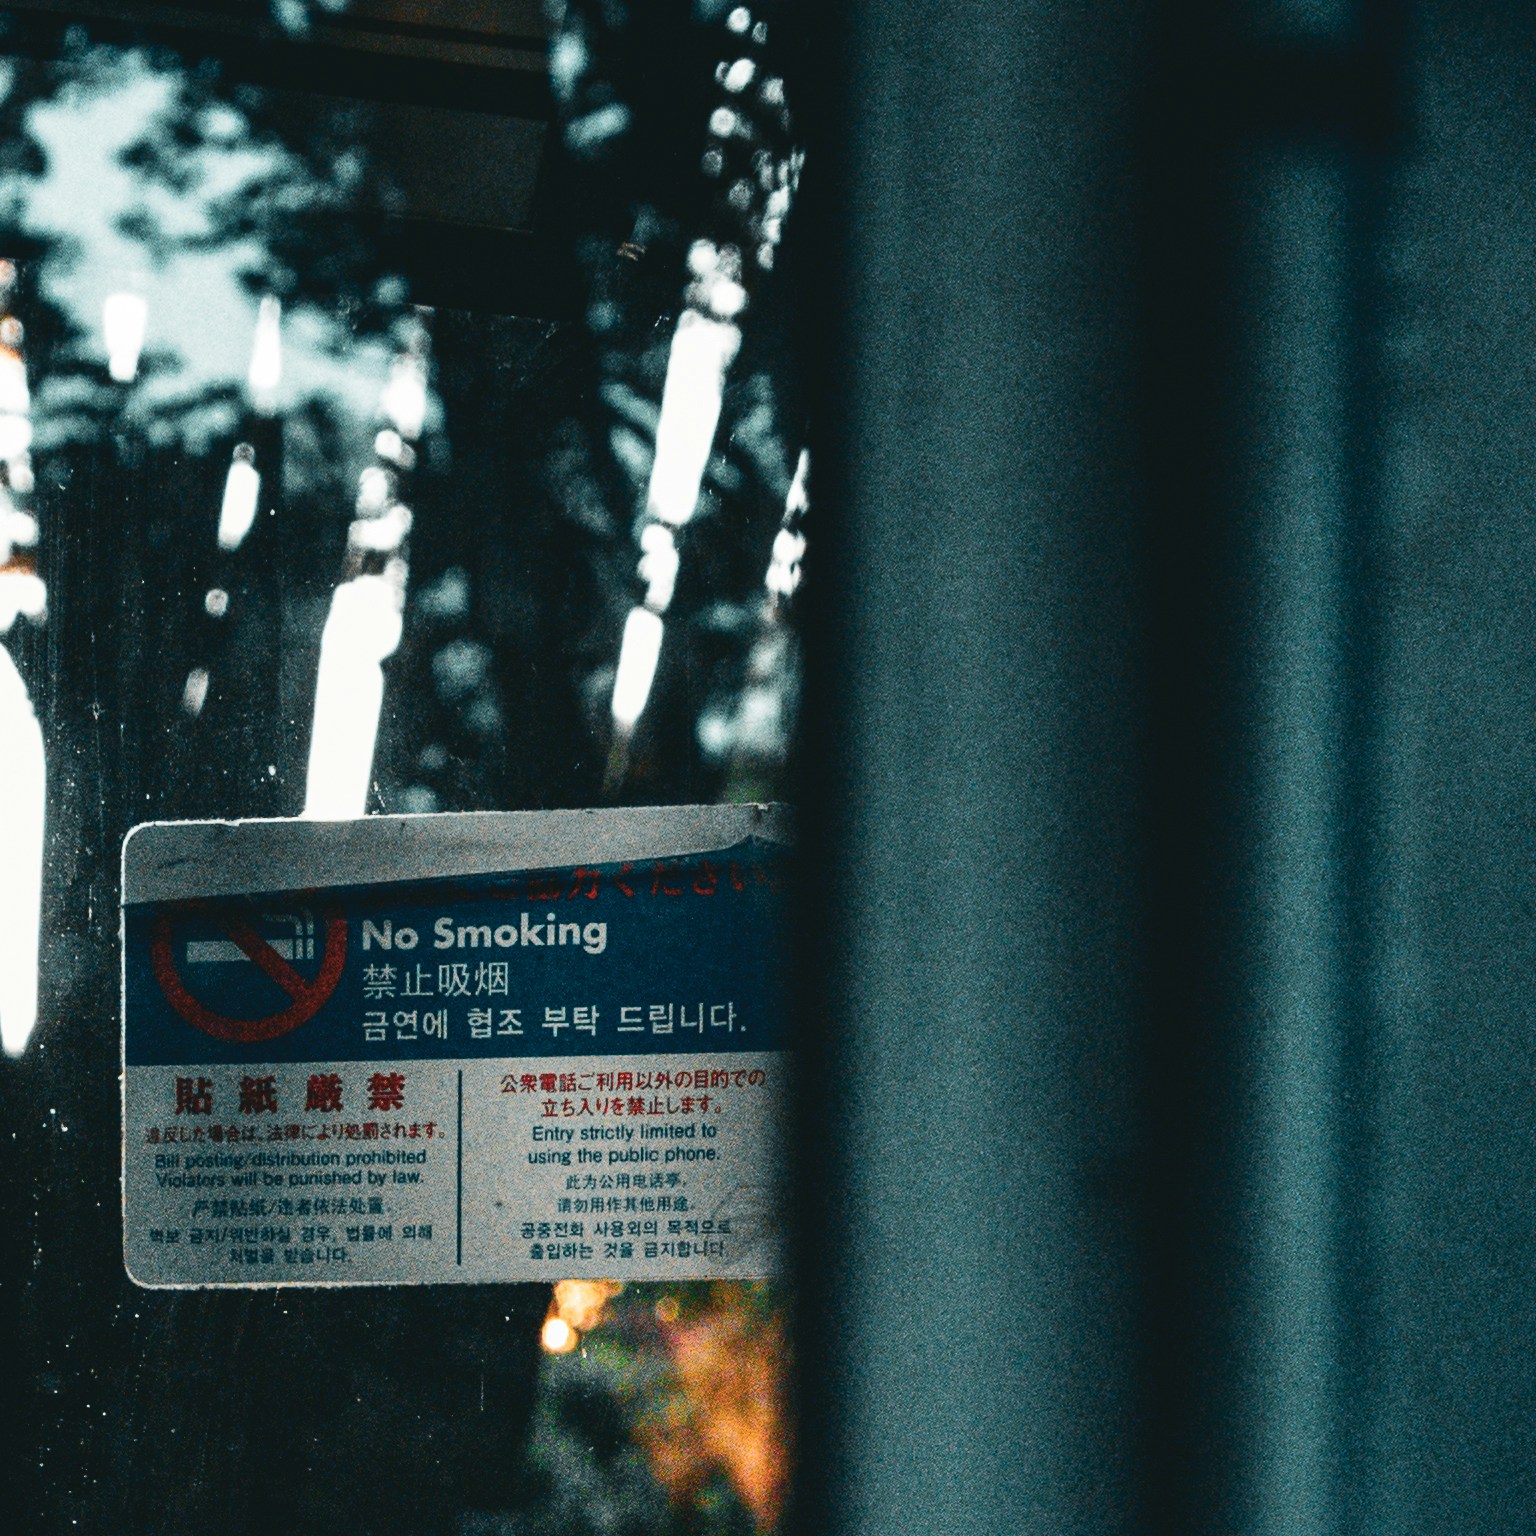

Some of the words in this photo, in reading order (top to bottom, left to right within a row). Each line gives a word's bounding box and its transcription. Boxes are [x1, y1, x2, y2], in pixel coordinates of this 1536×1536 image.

[363, 919, 418, 950] No
[434, 913, 607, 954] Smoking
[362, 961, 510, 999] 禁止吸烟
[362, 1008, 448, 1041] 금연에
[467, 1006, 523, 1039] 협조
[542, 1004, 600, 1037] 부탁
[617, 1000, 748, 1034] 드립니다.
[175, 1071, 406, 1115] 貼紙厳禁
[500, 1069, 766, 1094] 公衆電話ご利用以外の目的での
[541, 1095, 722, 1118] 立ち入りを禁止します。
[533, 1126, 573, 1142] Entry
[580, 1124, 633, 1142] strictly
[640, 1122, 696, 1139] limited
[702, 1123, 717, 1138] to
[155, 1154, 180, 1168] Bill
[346, 1149, 427, 1168] prohibited
[528, 1150, 571, 1166] using
[578, 1148, 602, 1163] the
[609, 1147, 659, 1165] public
[665, 1146, 720, 1163] phone.
[156, 1171, 225, 1187] Violators
[231, 1171, 257, 1186] will
[264, 1171, 283, 1186] be
[289, 1169, 362, 1188] punished
[367, 1169, 386, 1187] by
[393, 1168, 424, 1184] law.
[520, 1222, 584, 1239] 공중전화
